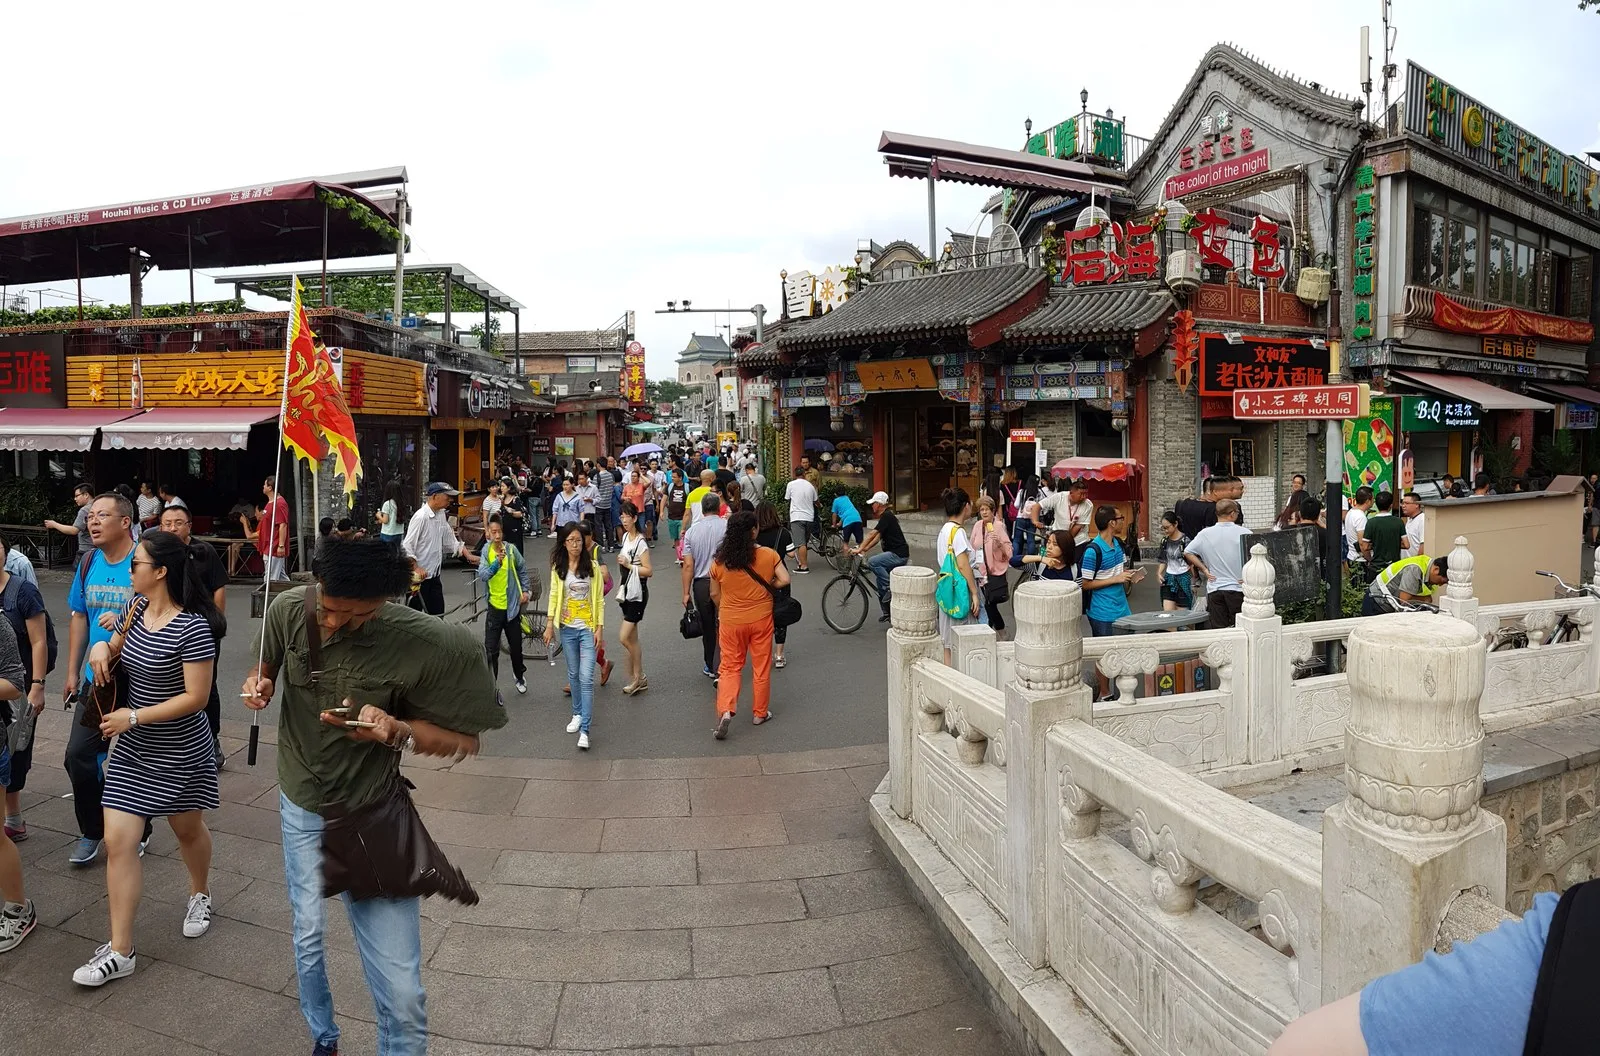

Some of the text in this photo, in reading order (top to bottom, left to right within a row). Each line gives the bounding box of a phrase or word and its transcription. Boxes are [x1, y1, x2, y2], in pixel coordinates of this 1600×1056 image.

[1168, 154, 1266, 194] The color of the night
[102, 196, 211, 219] Houhai Music & CD Live
[1061, 207, 1286, 285] 后海夜色
[1353, 164, 1375, 322] 清真李记涮肉
[1216, 361, 1324, 388] 老长沙大香肠
[1252, 391, 1352, 407] 小石碑胡同
[1445, 403, 1473, 417] 比淇尔
